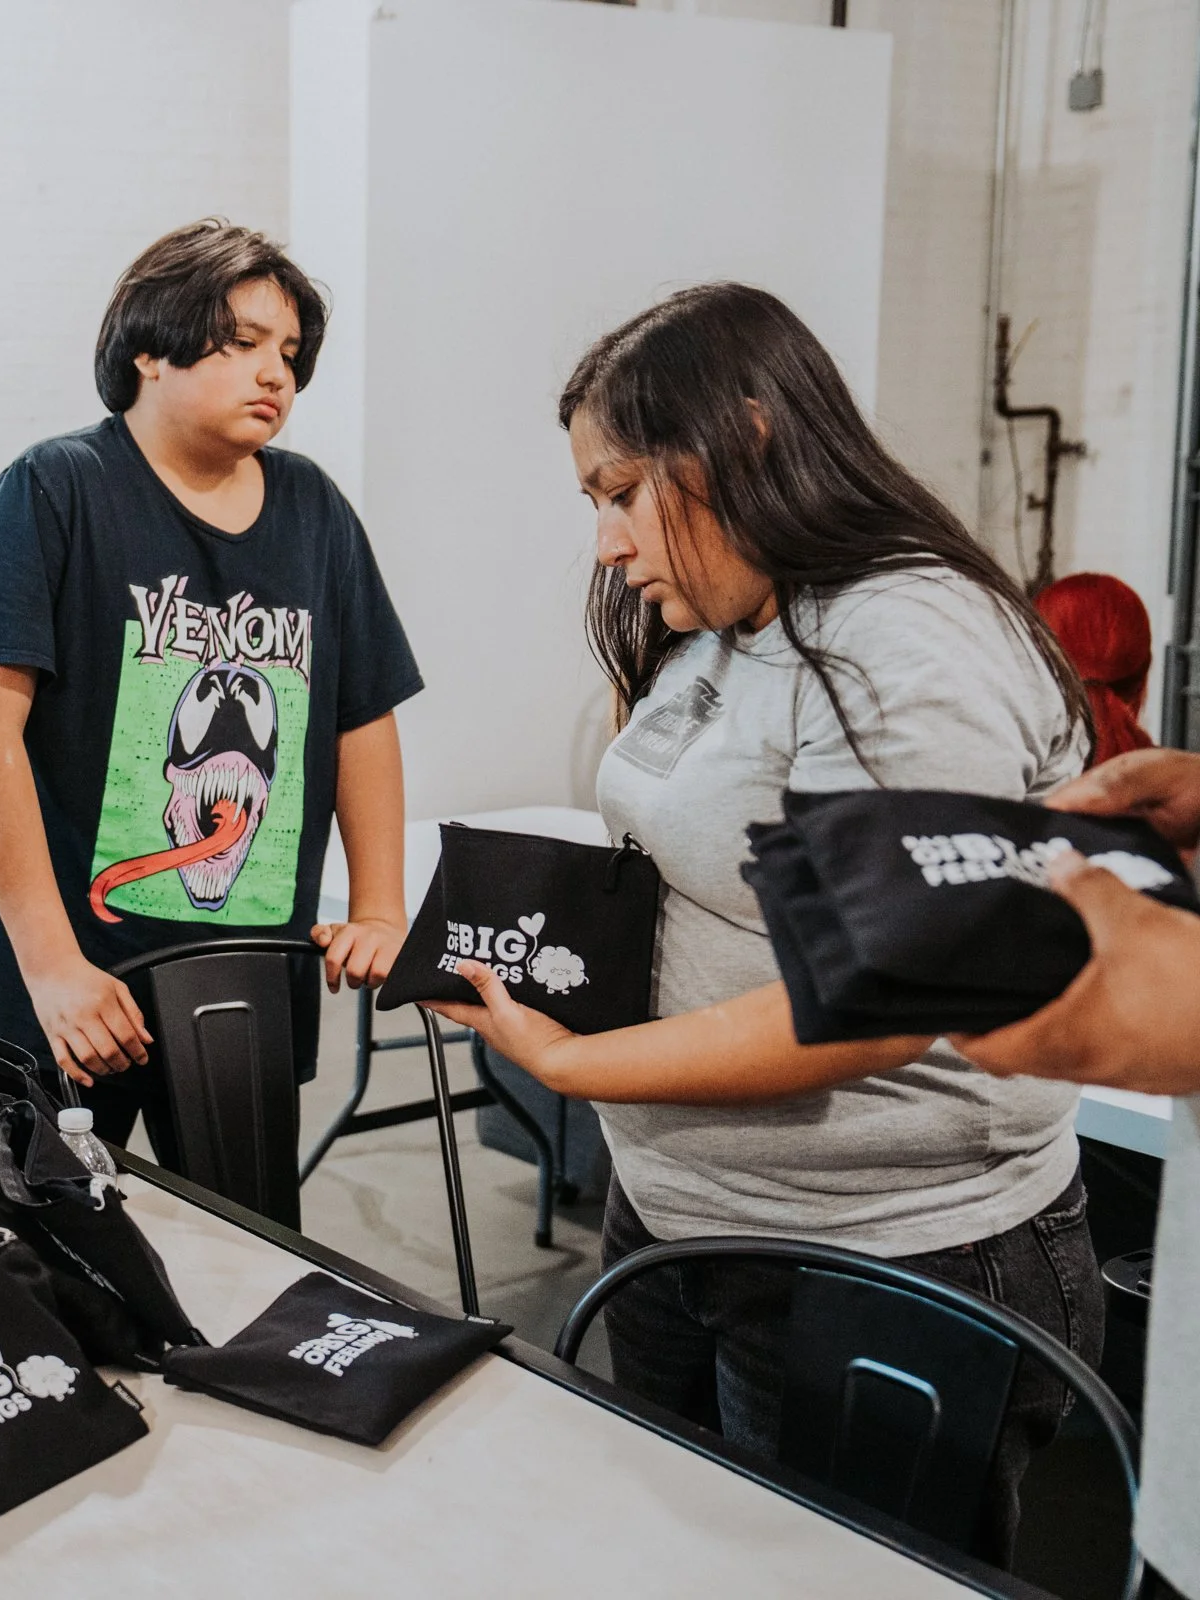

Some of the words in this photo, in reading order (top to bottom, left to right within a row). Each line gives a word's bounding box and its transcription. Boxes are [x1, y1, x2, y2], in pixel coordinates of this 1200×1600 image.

[128, 574, 313, 691] VENOM
[446, 933, 459, 952] OF
[458, 923, 527, 963] BIG
